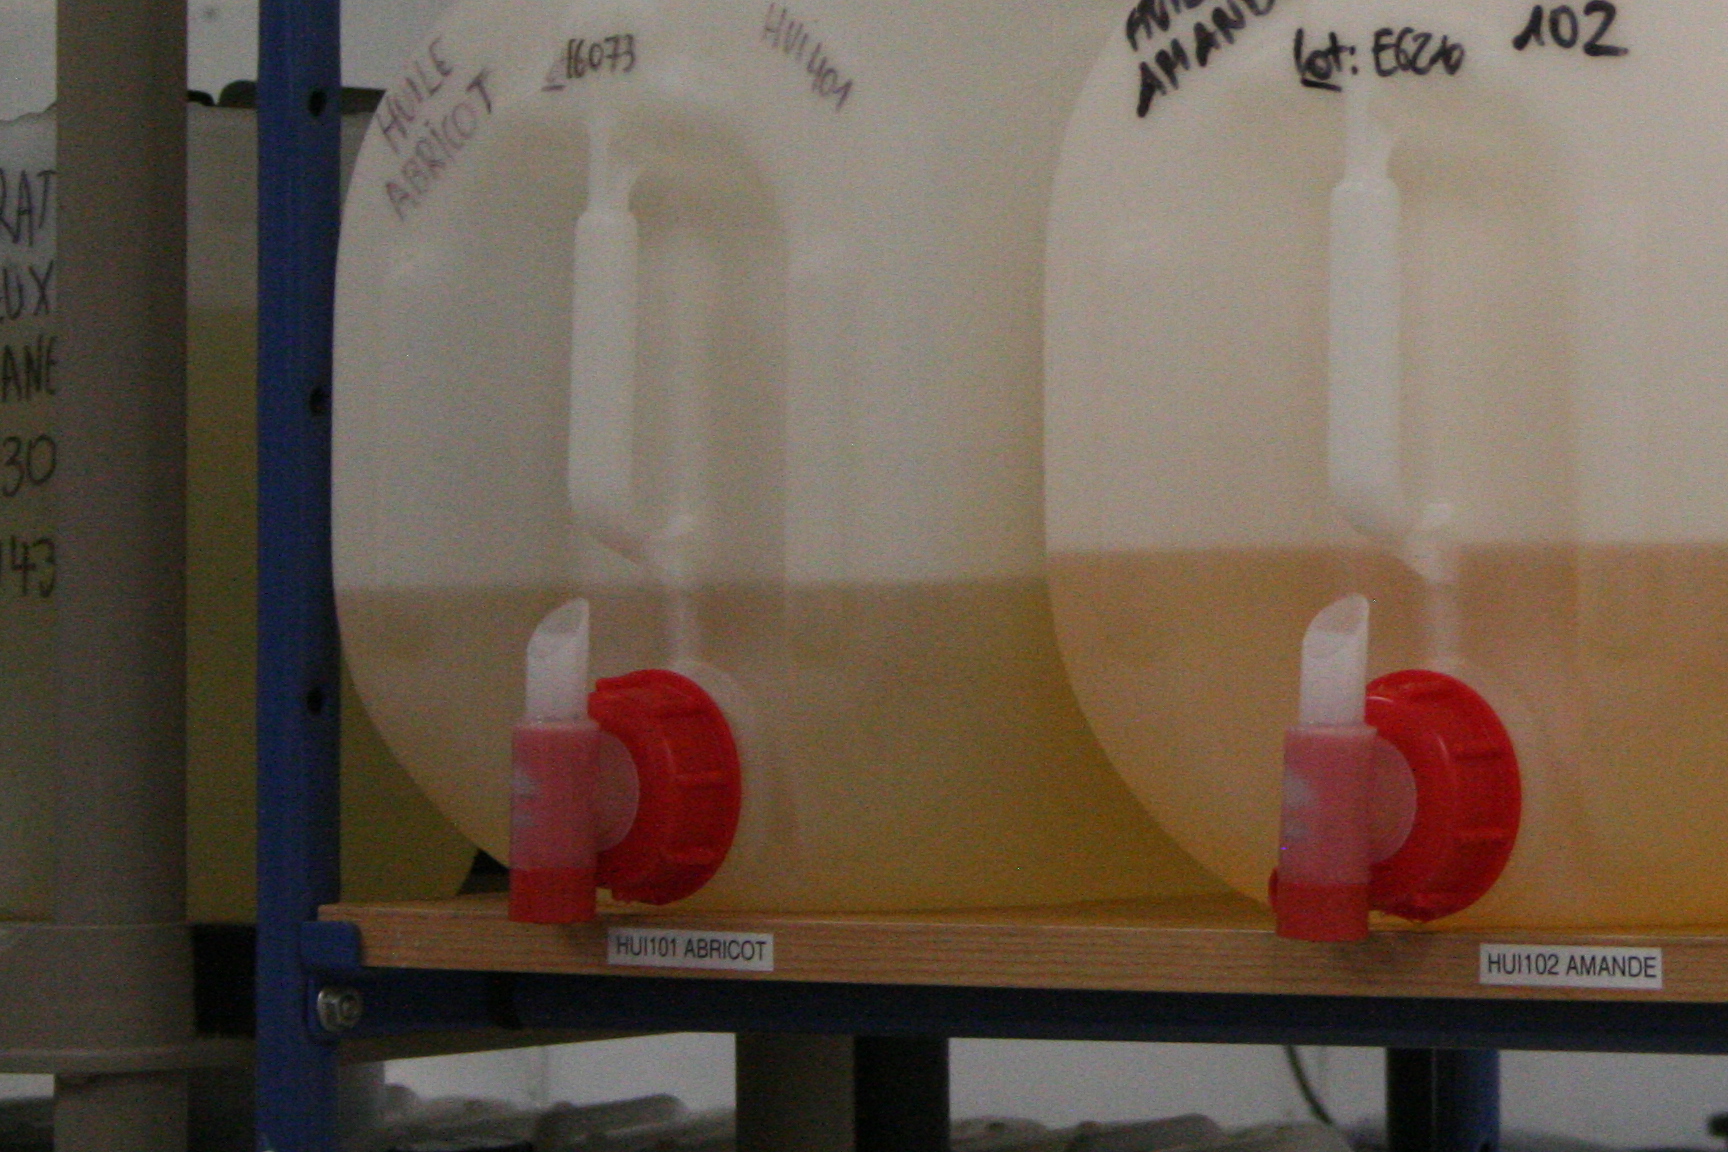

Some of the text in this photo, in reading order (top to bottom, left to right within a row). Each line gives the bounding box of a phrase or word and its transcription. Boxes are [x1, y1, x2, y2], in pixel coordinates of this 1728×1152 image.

[1511, 0, 1629, 57] 102
[617, 936, 766, 961] HUI101 ABRICOT
[1488, 953, 1657, 978] HUI102 AMANDE
